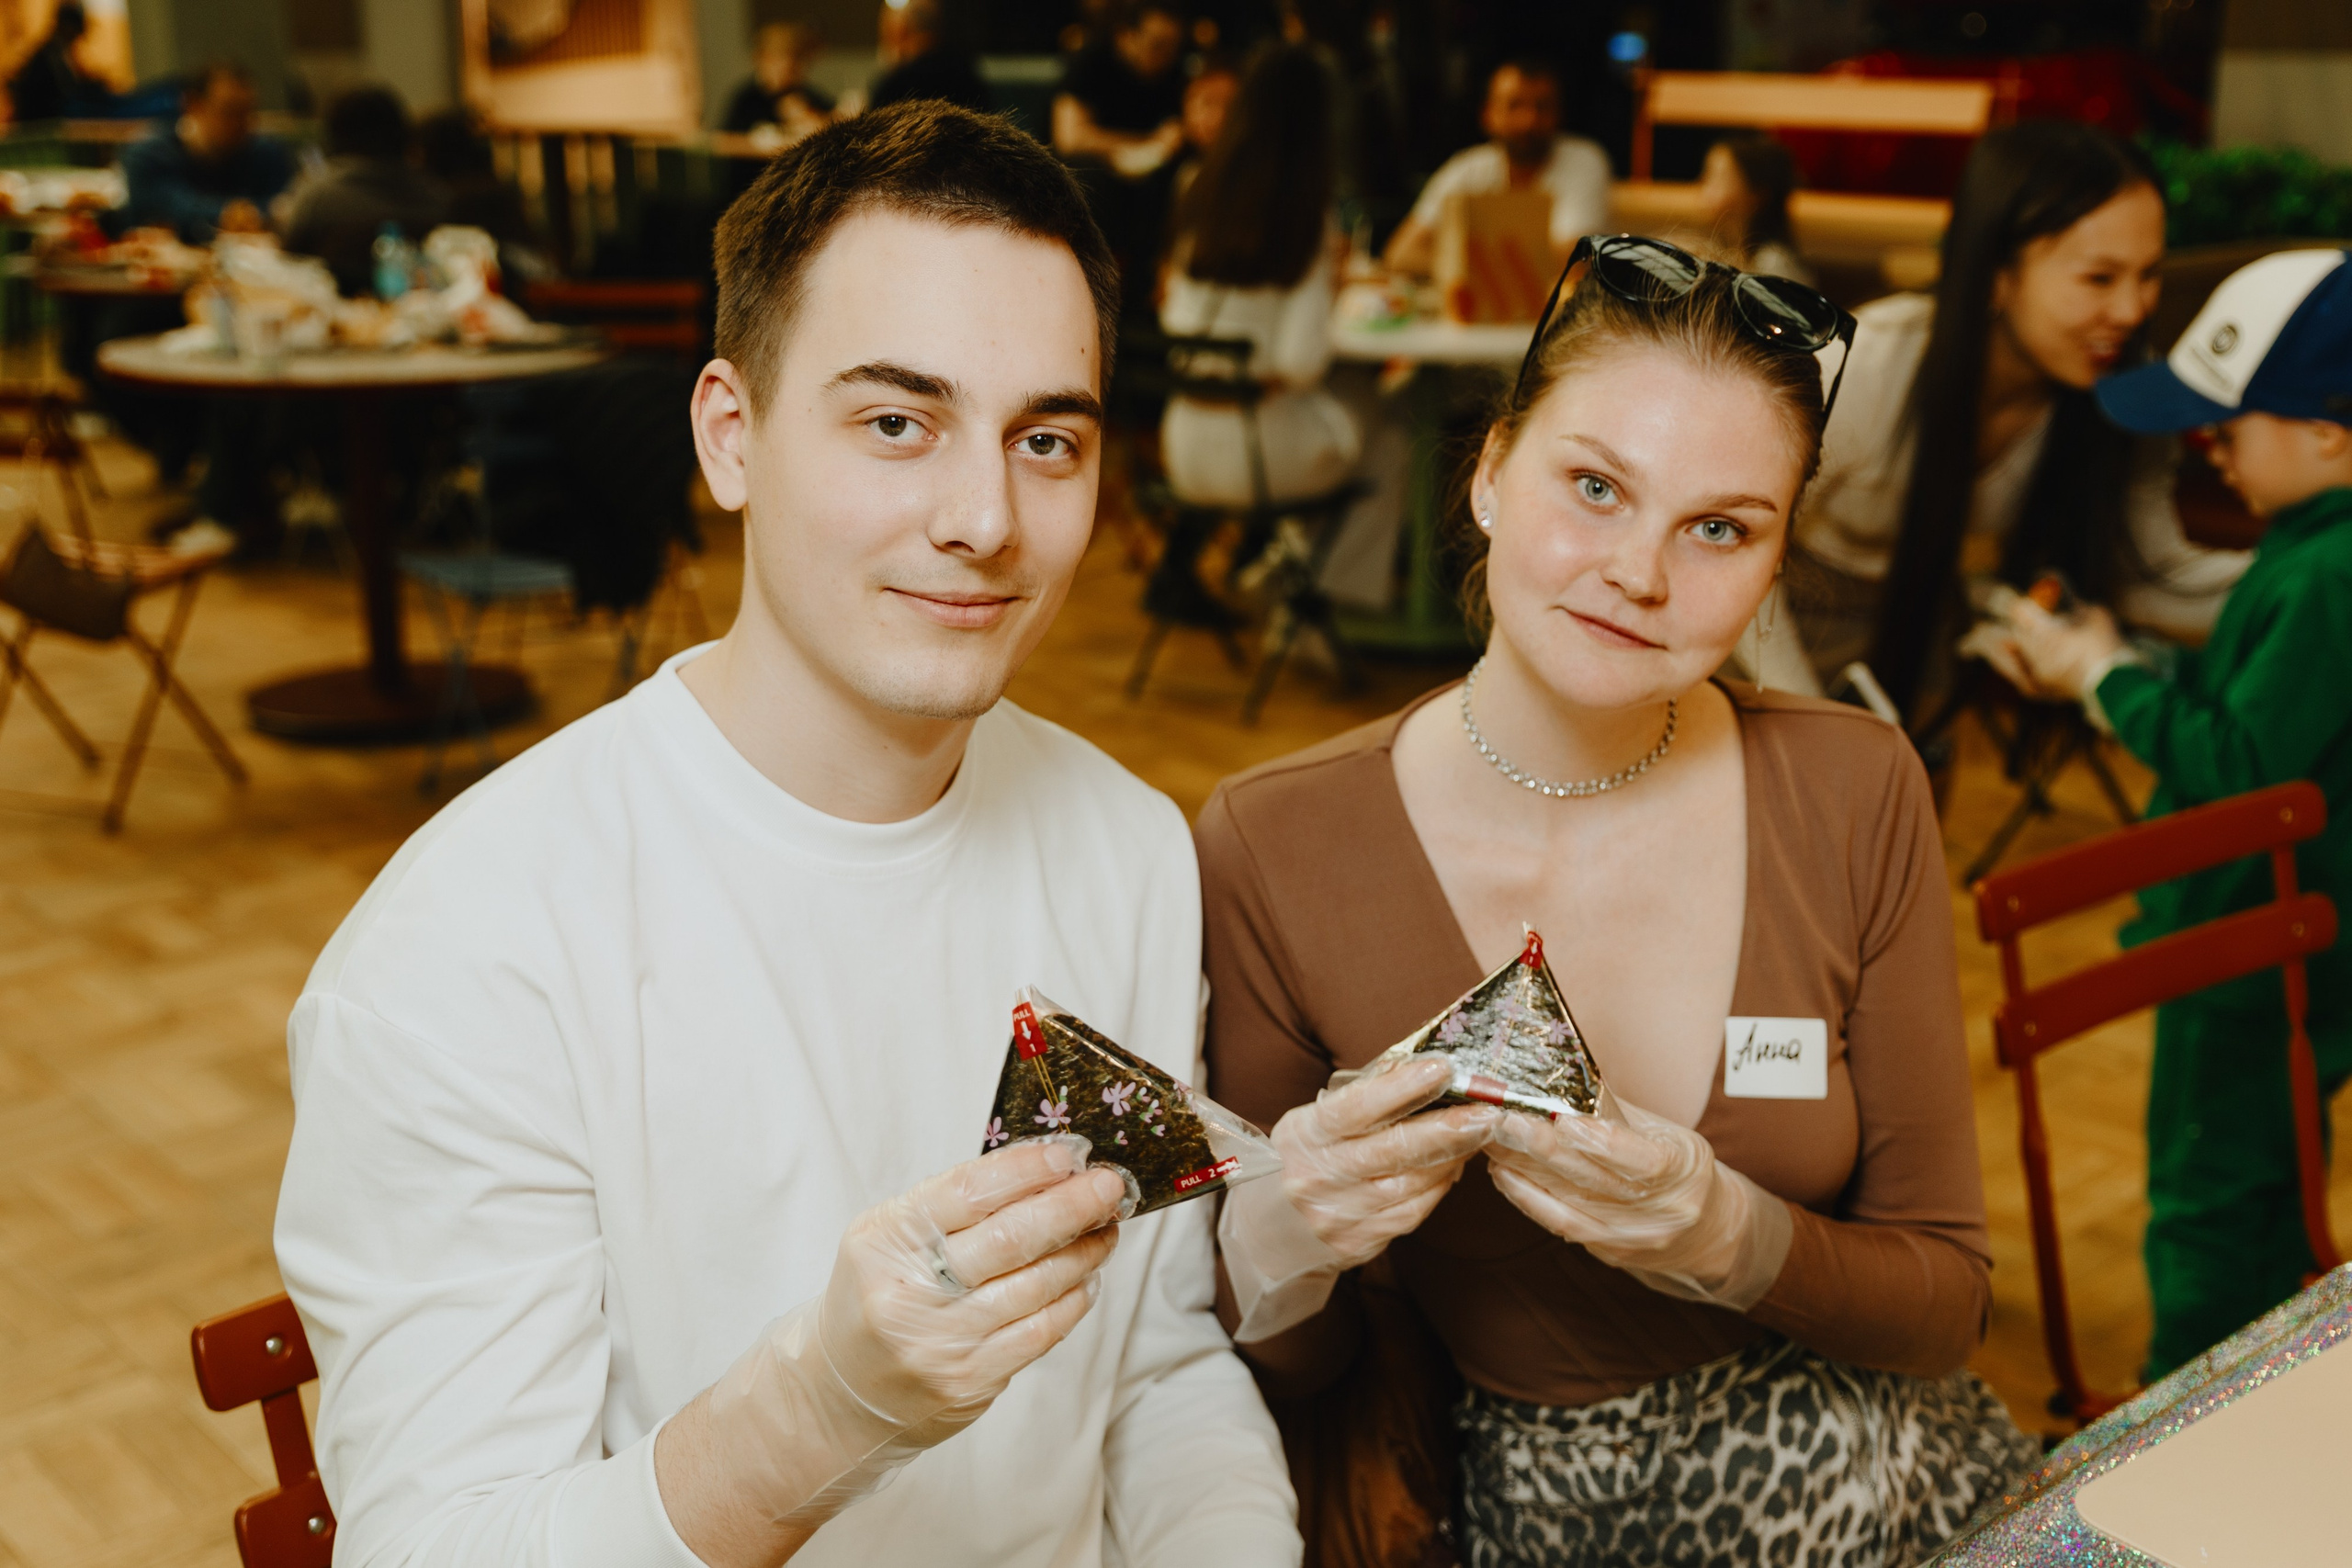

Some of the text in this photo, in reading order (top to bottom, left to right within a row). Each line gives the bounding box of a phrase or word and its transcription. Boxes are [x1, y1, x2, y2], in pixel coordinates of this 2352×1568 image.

[1013, 1009, 1031, 1021] PULL
[1029, 1043, 1036, 1053] 1
[1733, 1021, 1803, 1071] Анна
[1181, 1168, 1216, 1188] PULL 2
